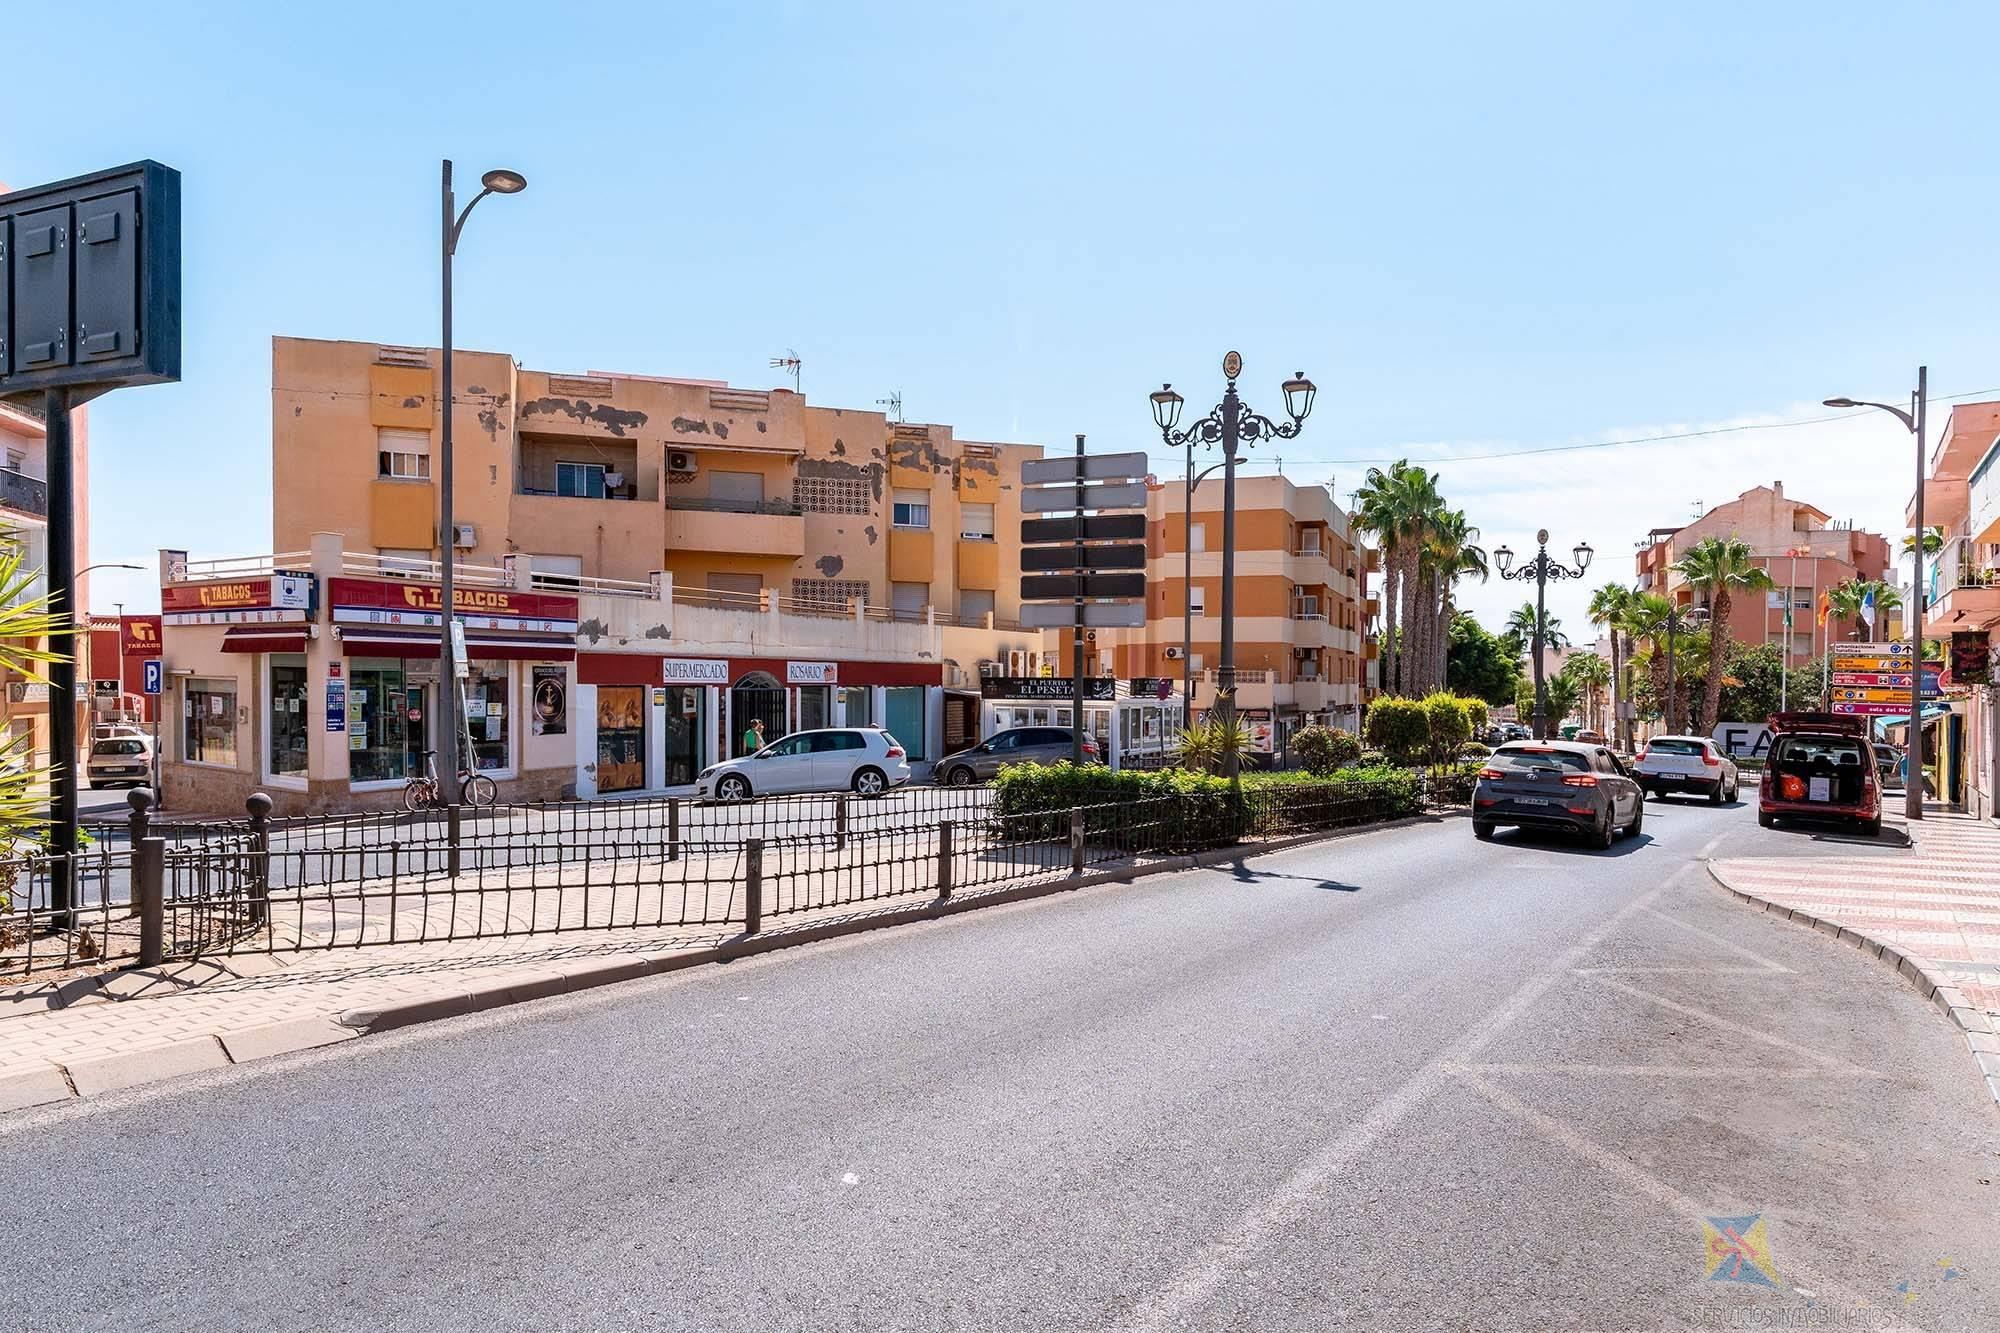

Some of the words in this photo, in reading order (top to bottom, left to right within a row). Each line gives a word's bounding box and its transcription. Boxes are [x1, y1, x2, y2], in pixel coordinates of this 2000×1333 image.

[211, 584, 251, 600] TABACOS
[427, 588, 509, 607] TBACOS
[147, 664, 158, 690] P
[664, 662, 728, 679] SUPERMERCADO
[790, 664, 822, 679] ROSARIO
[1021, 686, 1035, 695] EL
